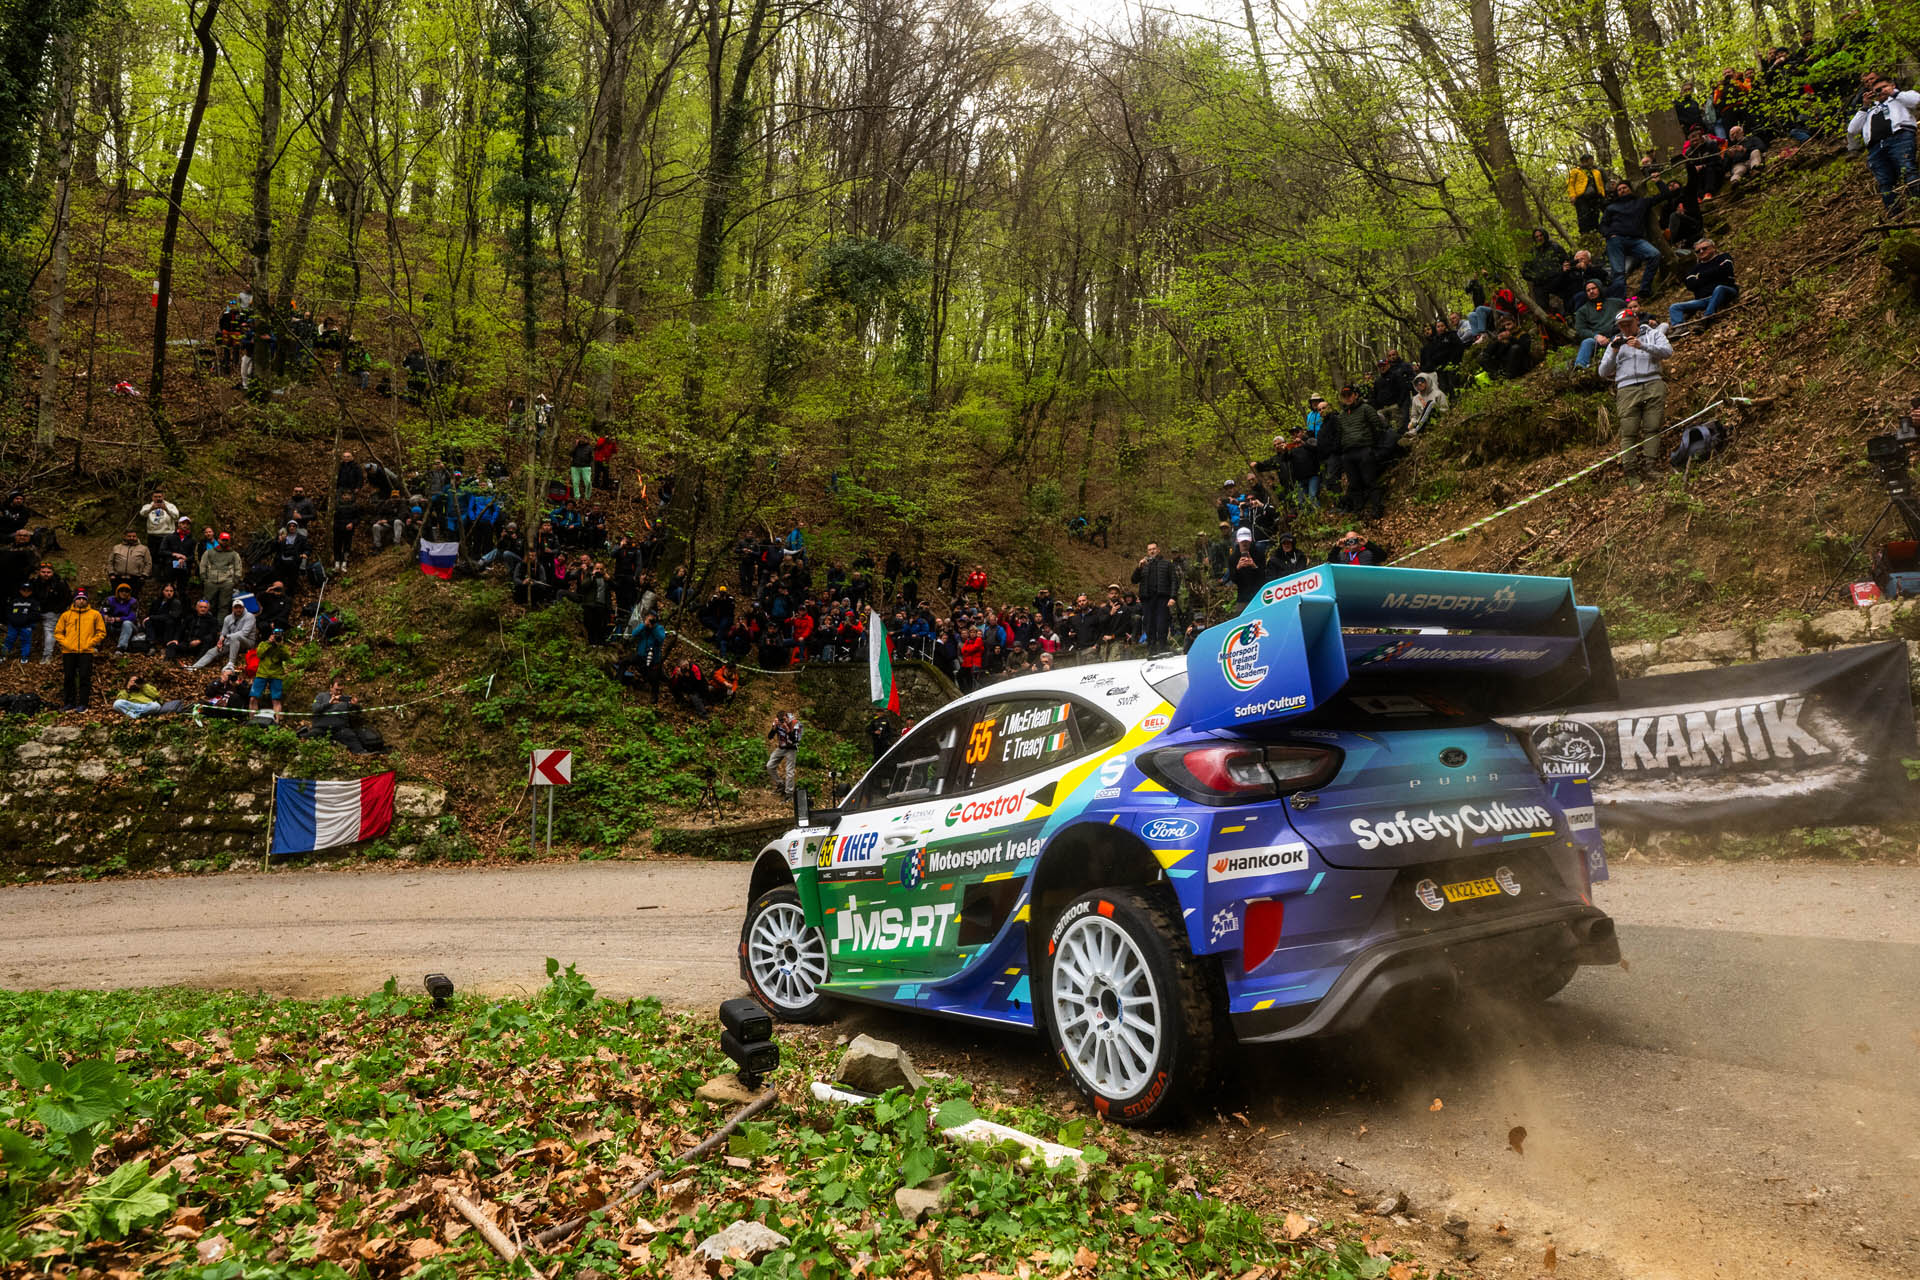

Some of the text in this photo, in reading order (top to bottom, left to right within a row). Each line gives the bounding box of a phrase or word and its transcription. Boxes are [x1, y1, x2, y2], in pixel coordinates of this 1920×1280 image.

[1274, 576, 1319, 600] Castrol
[1219, 644, 1258, 661] Motorsport
[1232, 653, 1257, 665] Ireland
[1399, 648, 1494, 660] Motorsport
[1236, 663, 1252, 672] Rally
[1236, 667, 1267, 679] Academy
[1234, 693, 1306, 718] SafetyCulture
[999, 707, 1051, 737] J McErlean
[1145, 718, 1165, 727] BELL
[966, 719, 996, 764] 55
[1617, 698, 1832, 771] KAMIK
[1003, 736, 1045, 762] E Treacy
[1543, 762, 1591, 774] KAMIK
[1409, 773, 1498, 788] PUMA
[962, 789, 1025, 823] Castrol
[1150, 820, 1188, 838] Ford
[1350, 801, 1553, 849] SafetyCulture
[819, 835, 838, 868] 55
[849, 832, 879, 861] HEP
[929, 844, 1001, 873] Motorsport
[1447, 883, 1475, 898] YX22
[1475, 880, 1496, 895] FCE
